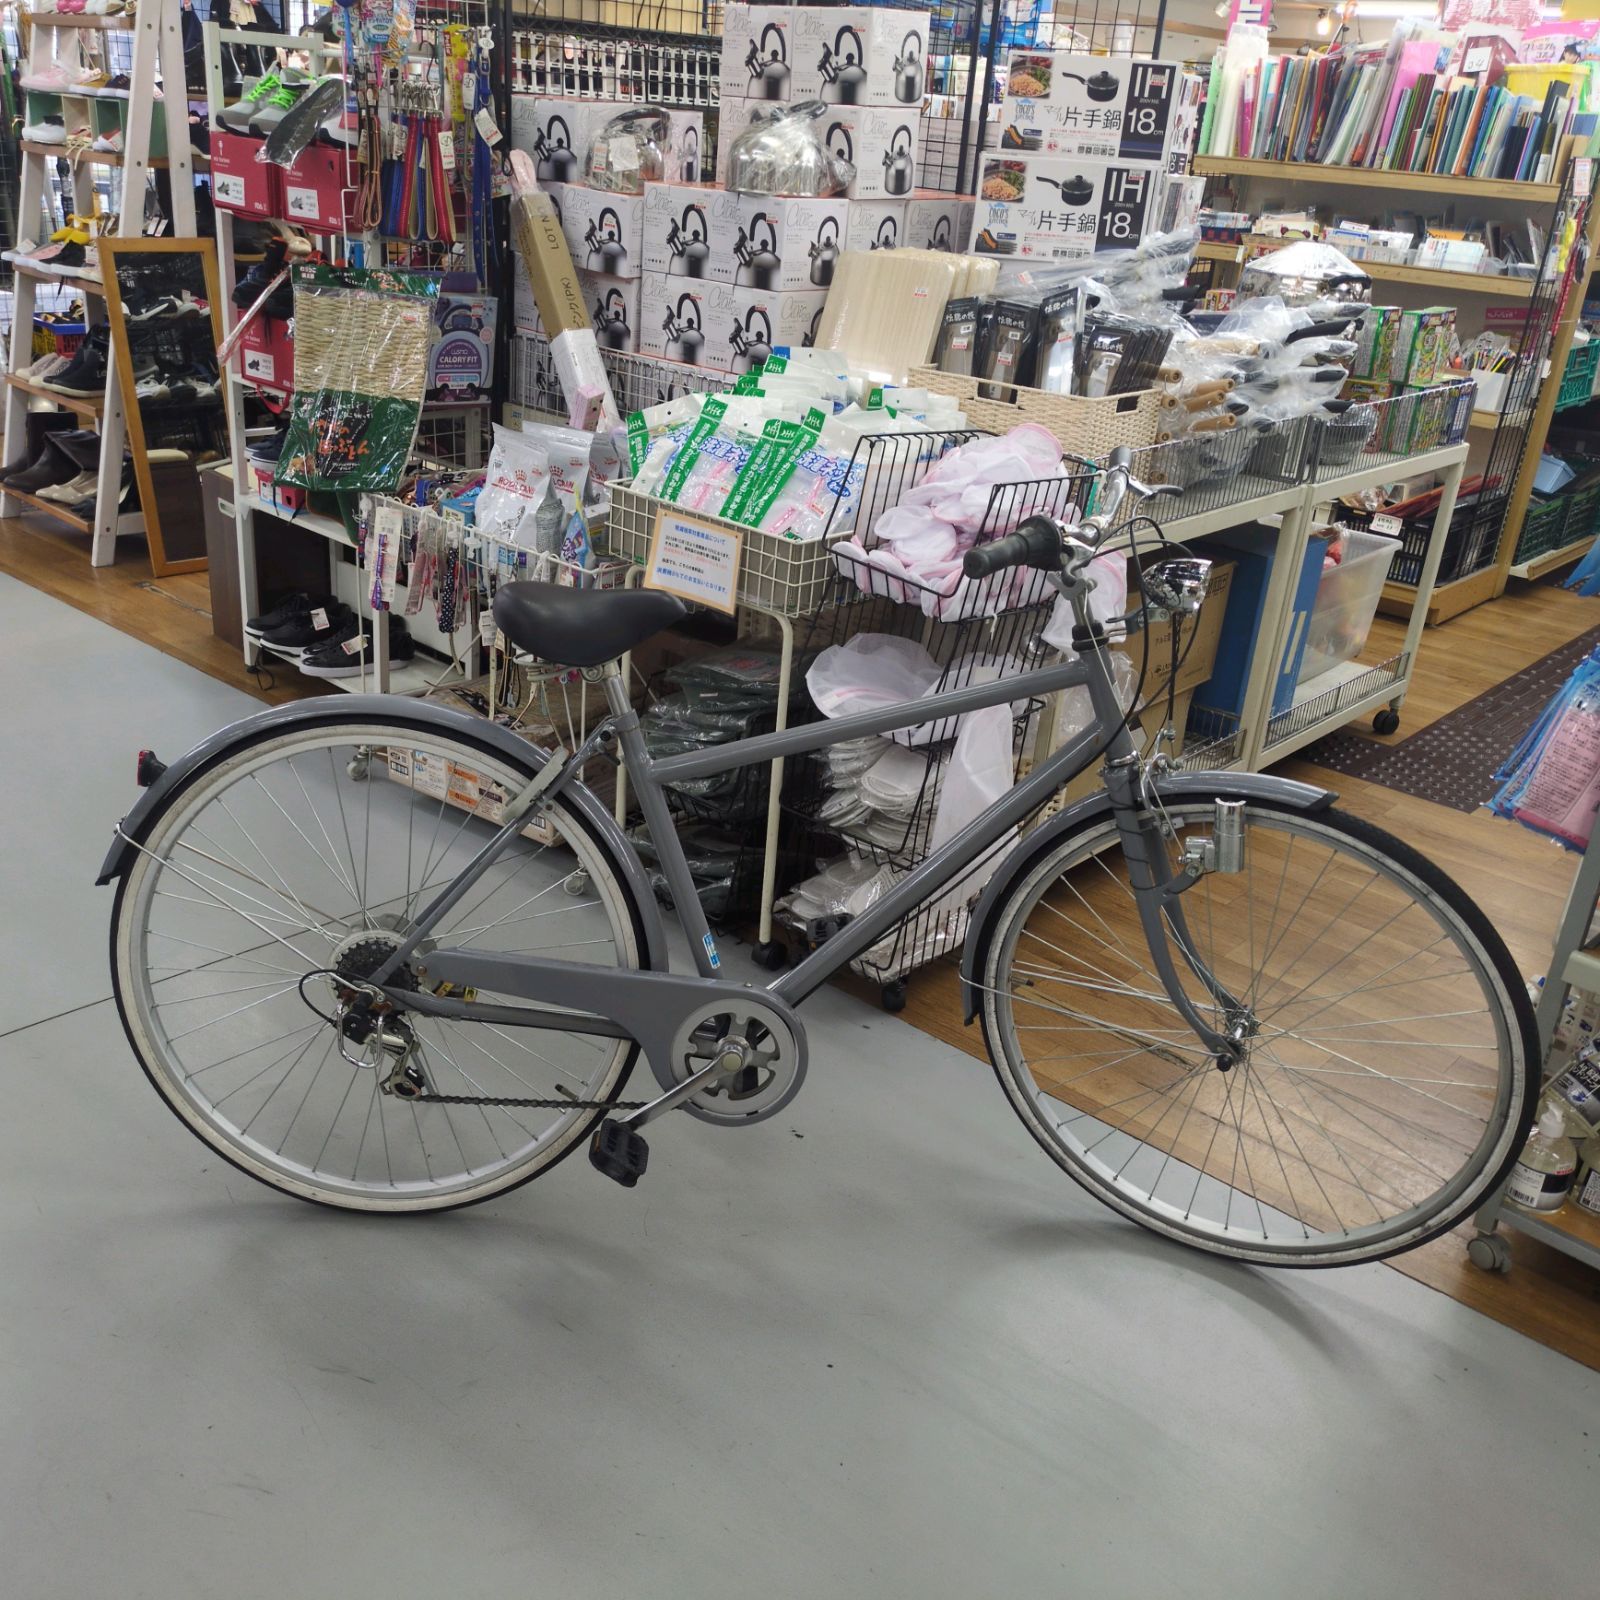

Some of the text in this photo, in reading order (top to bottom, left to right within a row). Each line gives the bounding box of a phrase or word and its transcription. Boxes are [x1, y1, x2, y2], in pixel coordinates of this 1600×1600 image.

[1134, 66, 1171, 99] IH
[1062, 106, 1122, 131] 片手鍋
[1108, 170, 1146, 203] IH
[1036, 210, 1097, 234] 片手鍋
[497, 475, 519, 490] ROYAL
